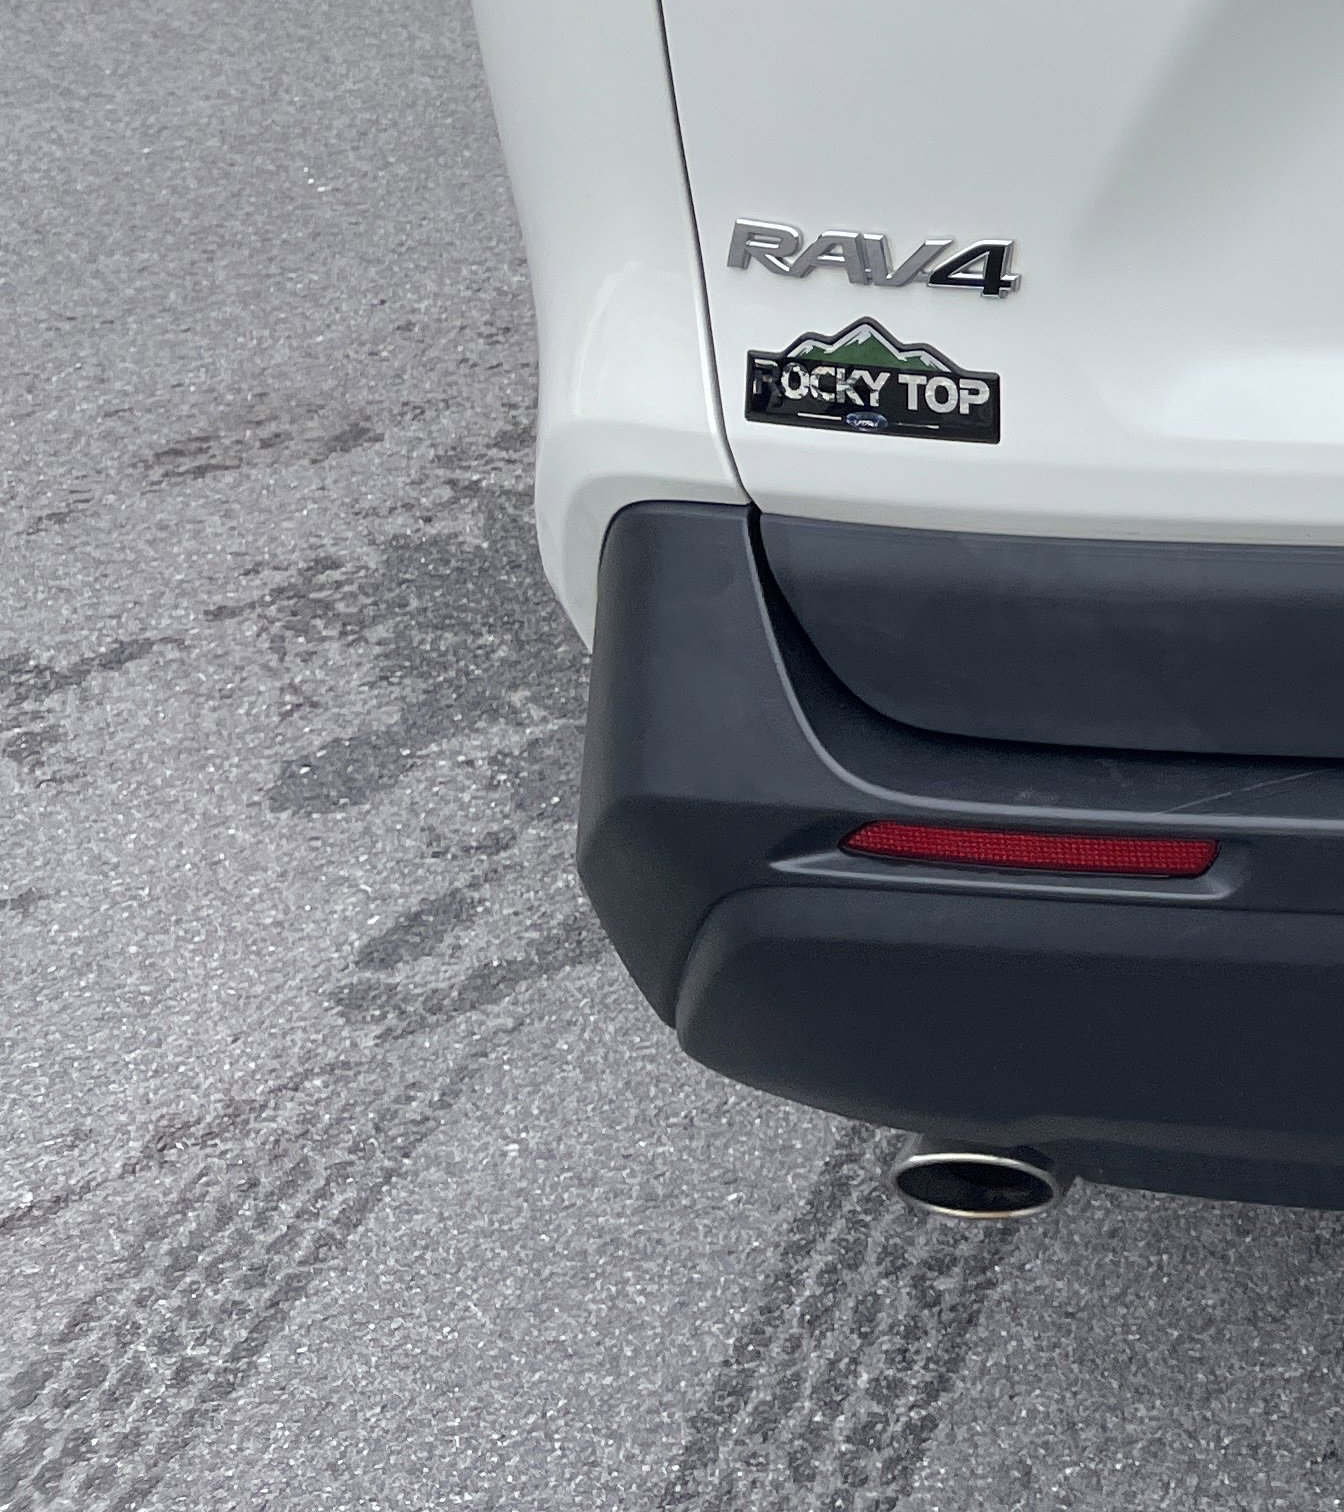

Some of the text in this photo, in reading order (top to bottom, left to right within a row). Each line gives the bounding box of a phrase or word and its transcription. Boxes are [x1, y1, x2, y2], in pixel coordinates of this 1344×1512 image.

[727, 217, 1022, 299] RAV4
[753, 359, 990, 415] ROCKY TOP
